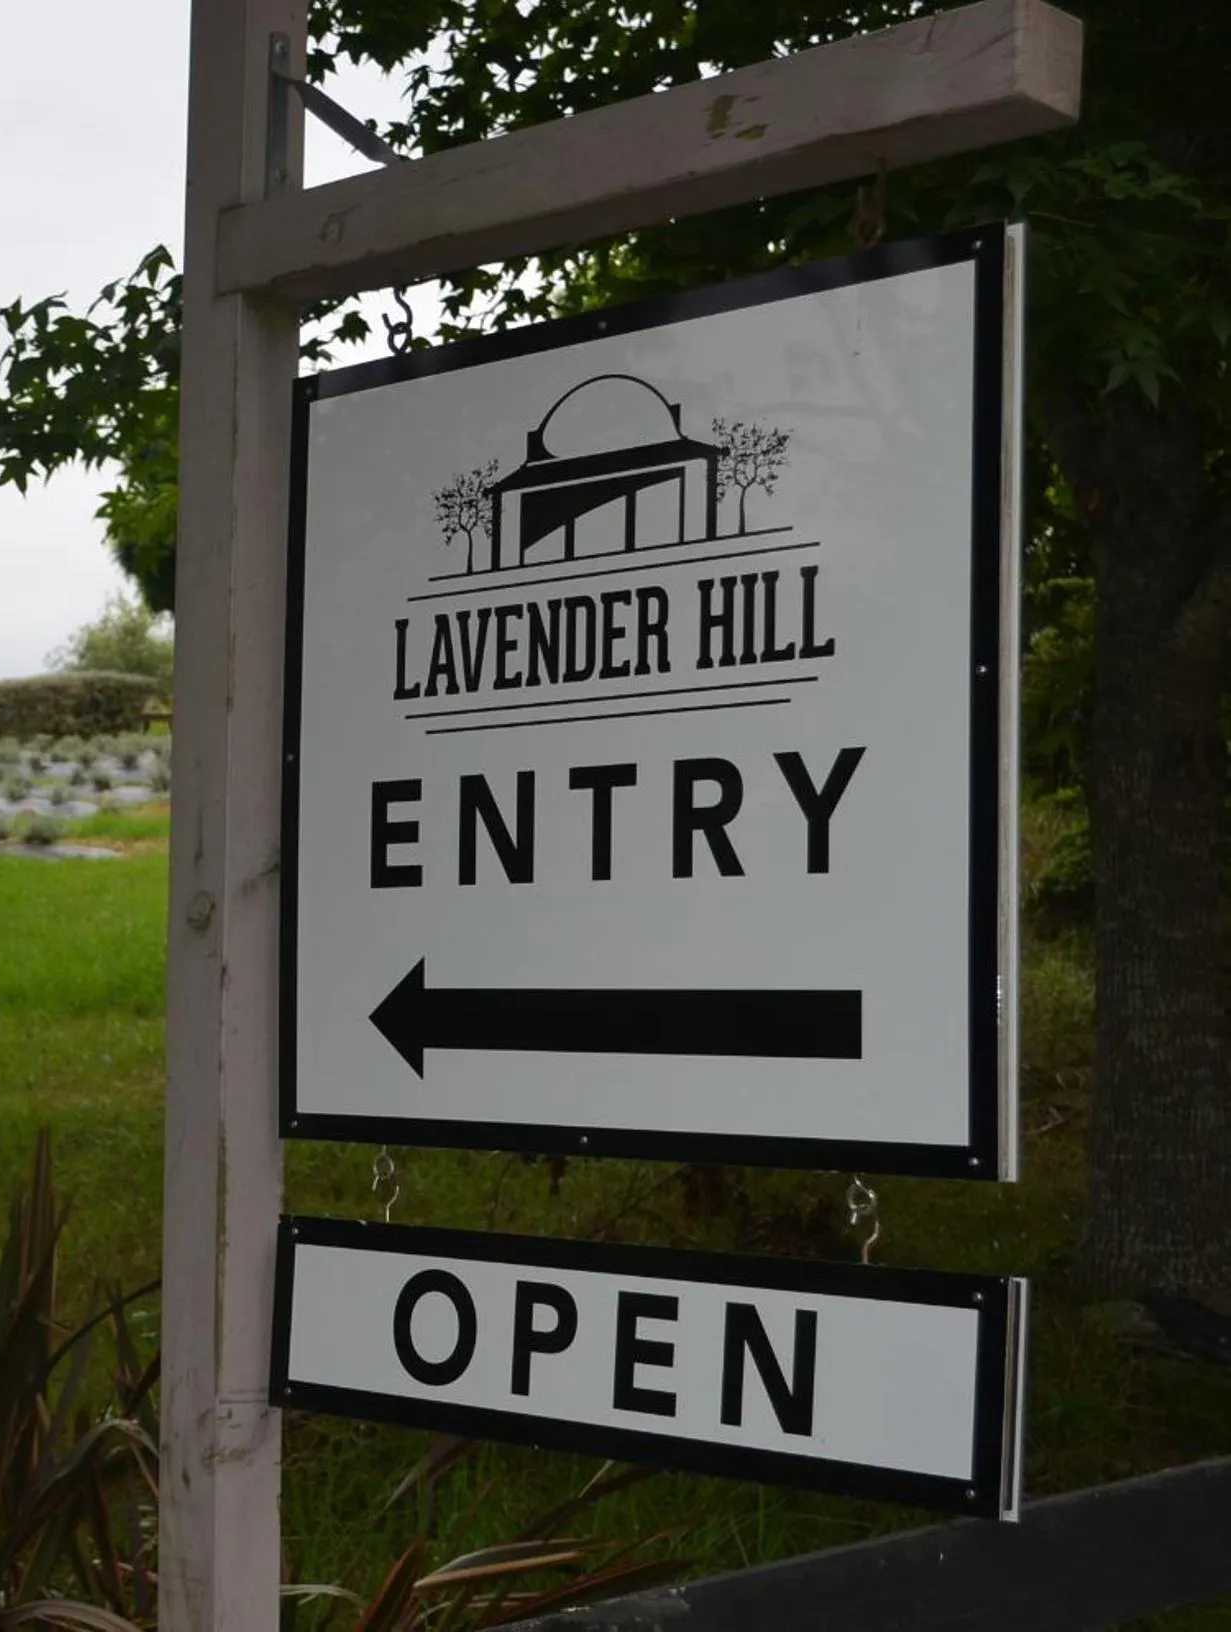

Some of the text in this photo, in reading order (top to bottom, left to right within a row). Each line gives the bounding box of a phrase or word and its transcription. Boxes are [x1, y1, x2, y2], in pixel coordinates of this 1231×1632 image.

[393, 565, 835, 701] LAVENDER HILL
[370, 746, 867, 889] ENTRY
[393, 1269, 818, 1437] OPEN
